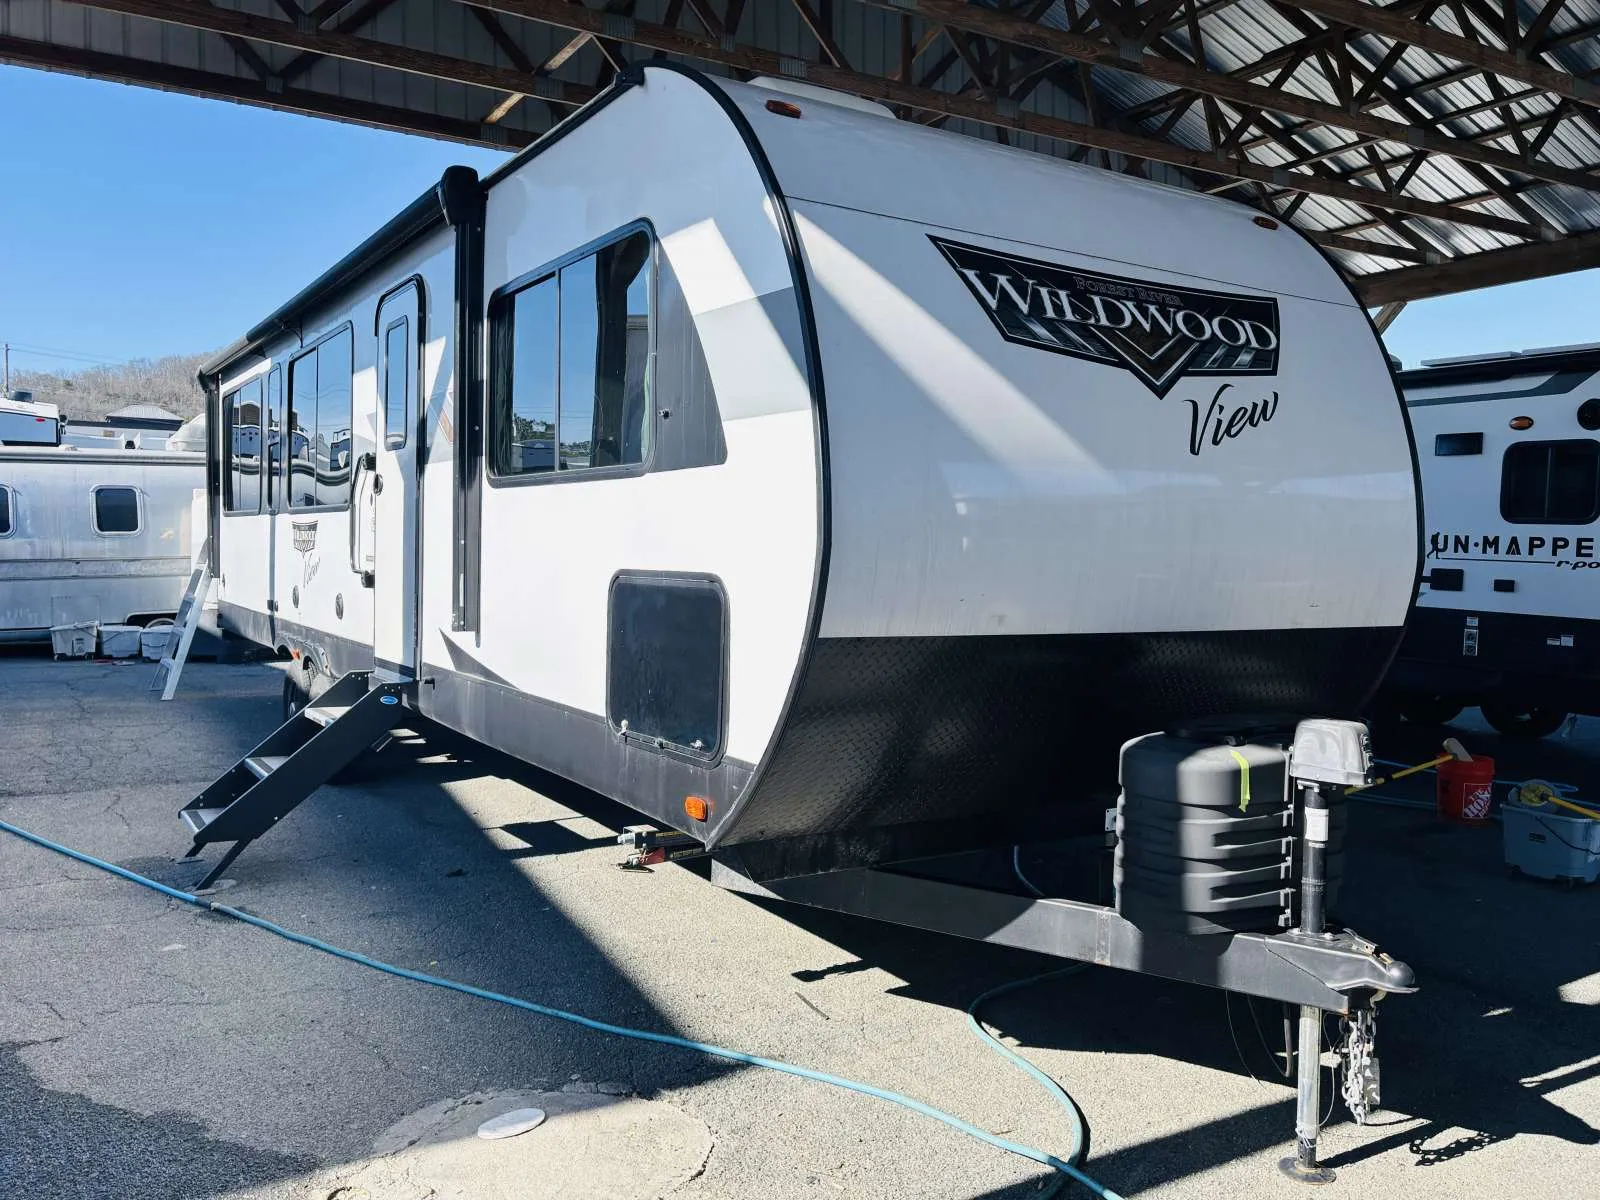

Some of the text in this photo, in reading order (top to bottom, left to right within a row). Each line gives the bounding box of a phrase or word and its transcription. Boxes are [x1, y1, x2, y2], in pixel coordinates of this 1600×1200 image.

[960, 268, 1277, 350] WILDWOOD
[1073, 276, 1184, 306] FOREST RIVER
[1183, 383, 1279, 456] View
